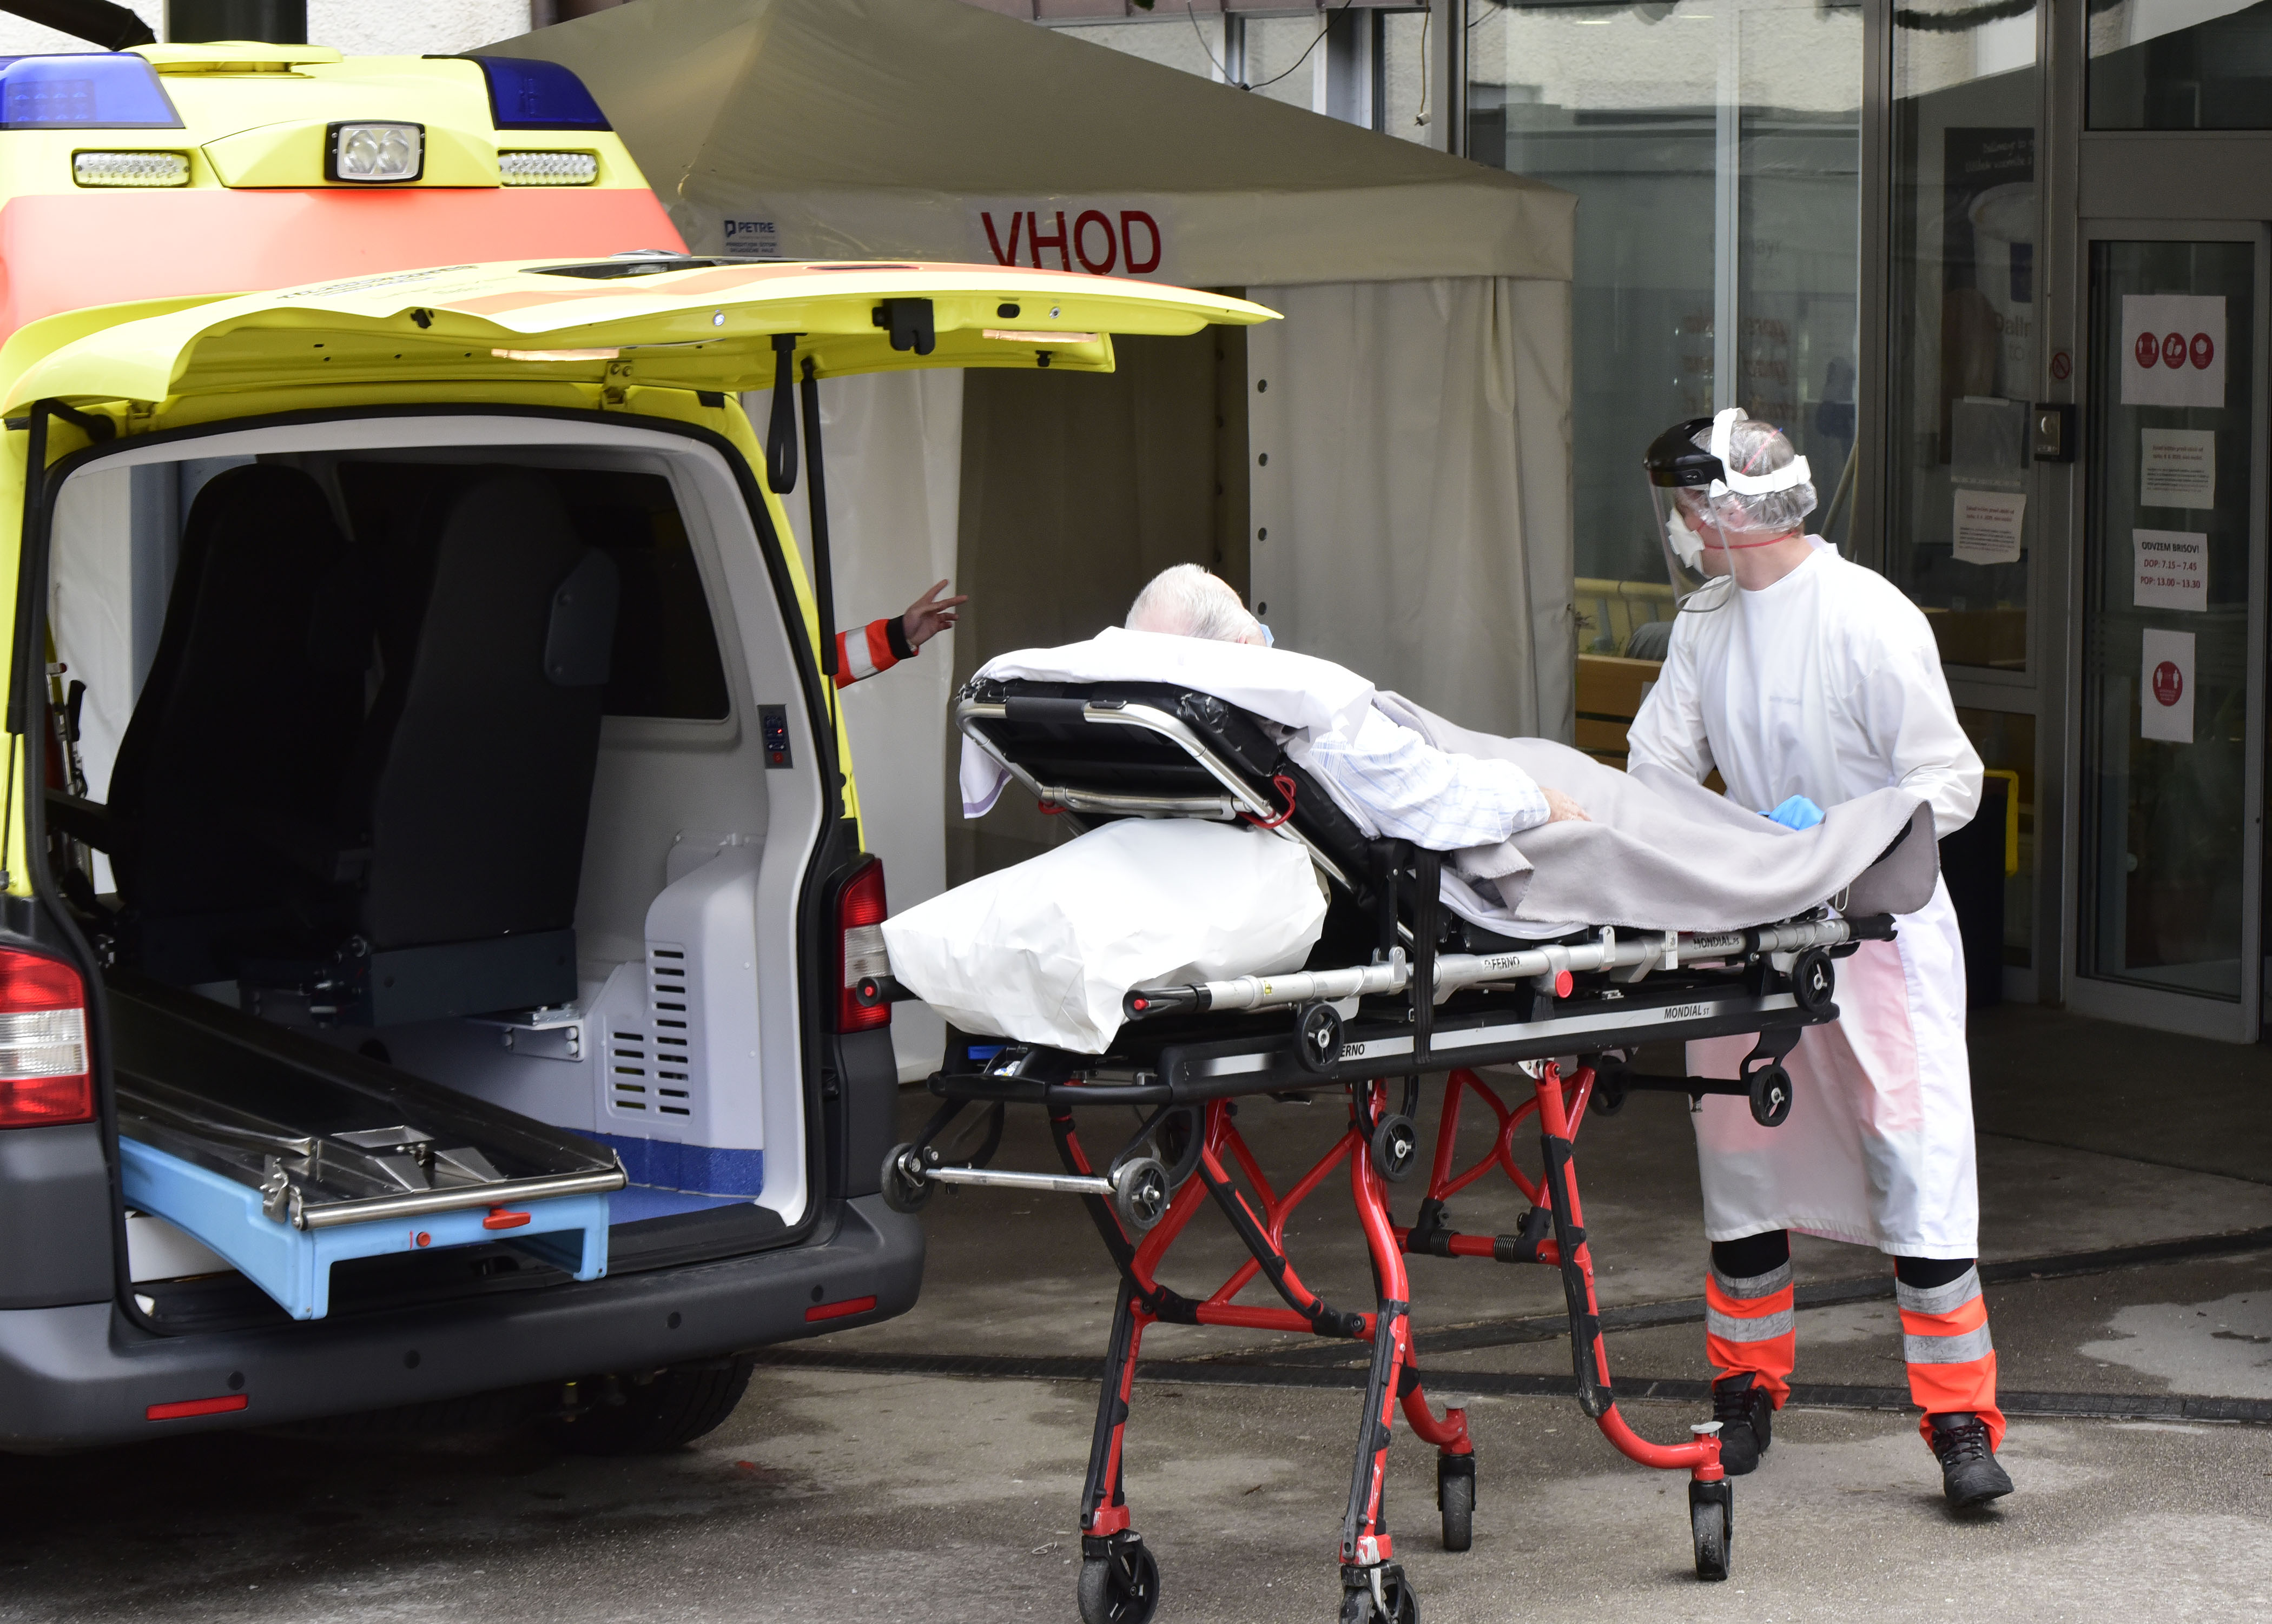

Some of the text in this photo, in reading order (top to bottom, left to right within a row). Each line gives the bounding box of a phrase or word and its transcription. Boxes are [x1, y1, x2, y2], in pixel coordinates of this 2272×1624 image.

[738, 222, 775, 233] PETRE
[981, 210, 1161, 275] VHOD
[2142, 542, 2199, 553] ODVZEM BRISOV!
[1693, 936, 1731, 950] MONDIAL
[1491, 956, 1520, 970] FERNO
[1664, 1005, 1702, 1019] MONDIAL
[1341, 1043, 1365, 1057] ERNO
